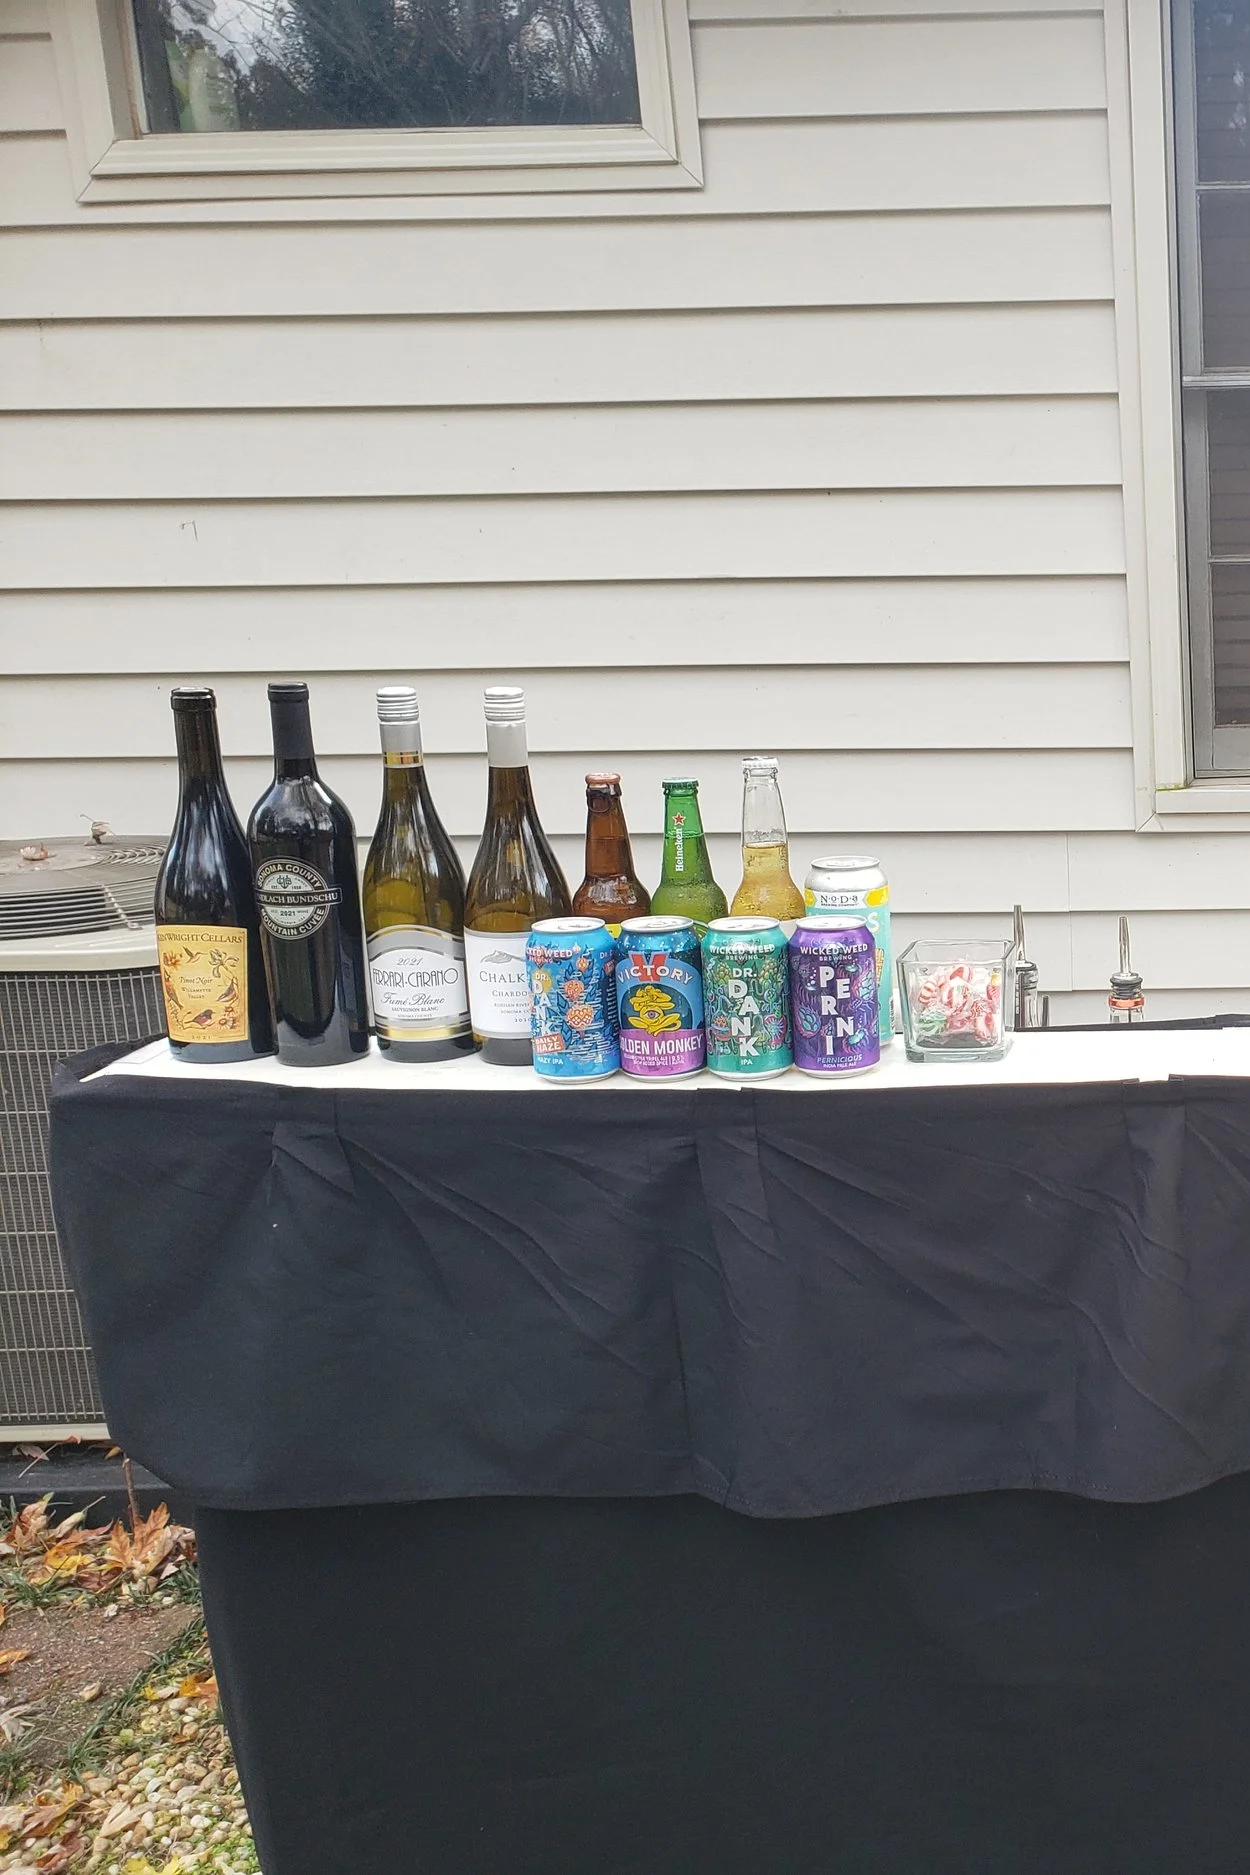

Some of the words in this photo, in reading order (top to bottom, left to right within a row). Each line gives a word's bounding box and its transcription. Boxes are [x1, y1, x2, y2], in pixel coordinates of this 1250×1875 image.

[675, 828, 684, 872] Heineken
[257, 864, 283, 888] SONOMA
[285, 864, 322, 888] COUNTY
[286, 892, 338, 904] BUNDSCHU
[261, 908, 298, 936] MOUNTAIN
[200, 932, 242, 944] CELLARS
[544, 949, 573, 958] WEED
[710, 945, 745, 955] WICKED
[749, 943, 775, 954] WEED
[800, 946, 839, 956] WICKED
[843, 943, 868, 955] WEED
[397, 957, 423, 966] 2021
[479, 970, 526, 984] CHALK
[618, 964, 693, 985] VICTORY
[732, 968, 757, 978] DR.
[409, 993, 445, 1006] Blanc
[536, 1041, 562, 1053] HAZE
[654, 1034, 702, 1055] MONKEY
[817, 1055, 863, 1064] PERNICIOUS
